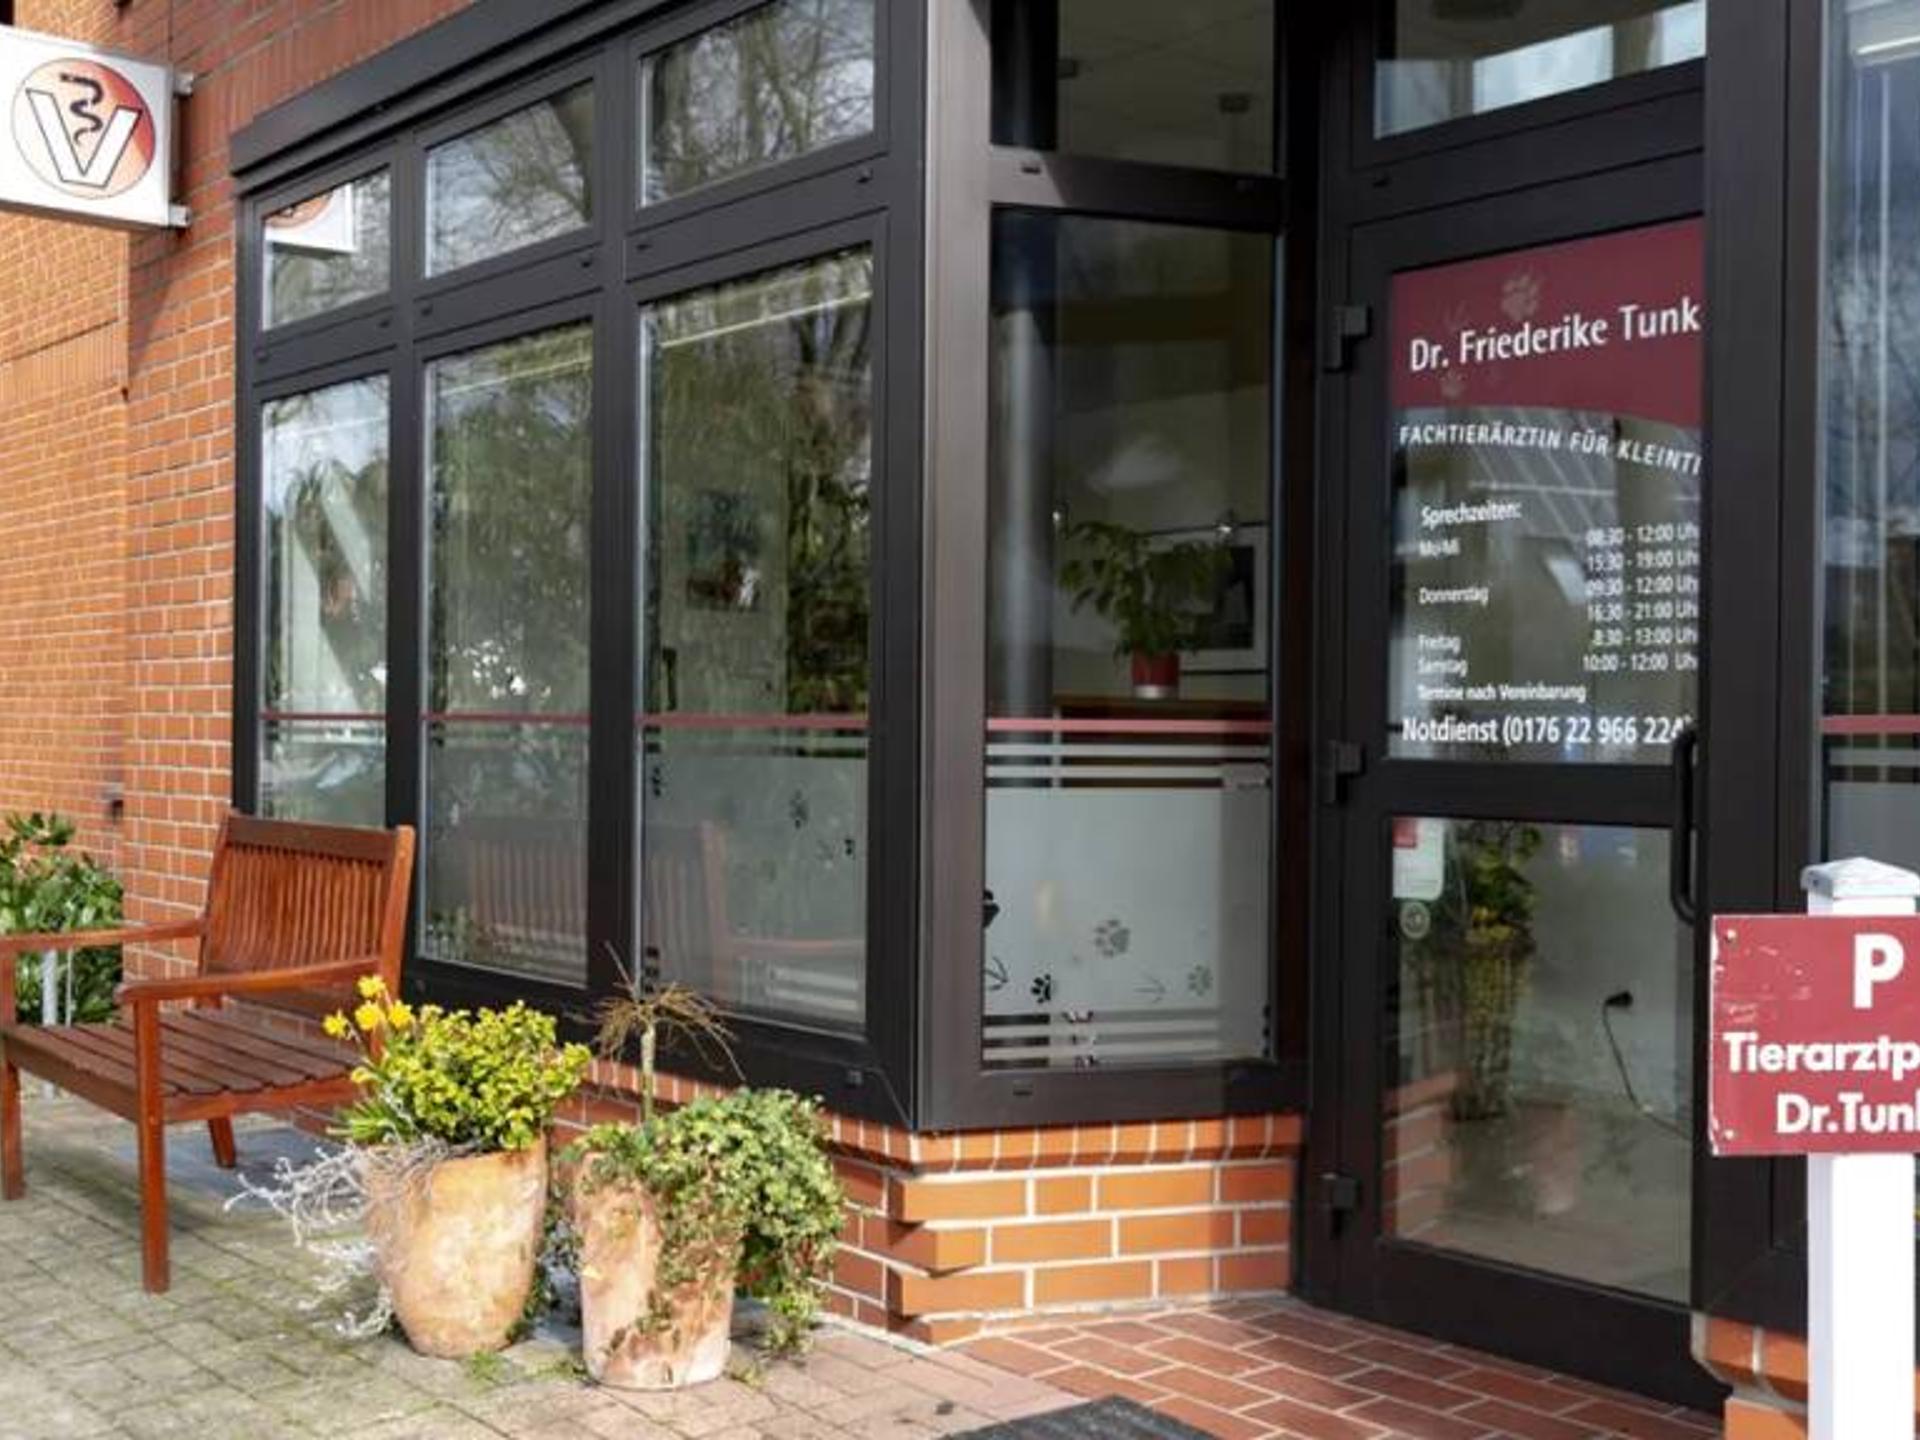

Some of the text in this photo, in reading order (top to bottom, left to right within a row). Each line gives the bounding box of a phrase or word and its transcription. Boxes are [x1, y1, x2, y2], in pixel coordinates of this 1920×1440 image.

[1410, 296, 1701, 373] Dr. Friederike Tunk
[1399, 421, 1563, 450] FACHTIERÄRZTIN
[1569, 428, 1609, 456] FÜR
[1466, 683, 1496, 699] nach
[1499, 682, 1587, 703] Vereinbarung
[1402, 714, 1499, 742] Notdienst
[1502, 715, 1560, 746] (0176
[1565, 716, 1592, 743] 22
[1598, 716, 1637, 744] 966
[1853, 932, 1905, 1009] P
[1722, 1031, 1920, 1081] Tierarztp
[1776, 1088, 1920, 1134] Dr.Tun
